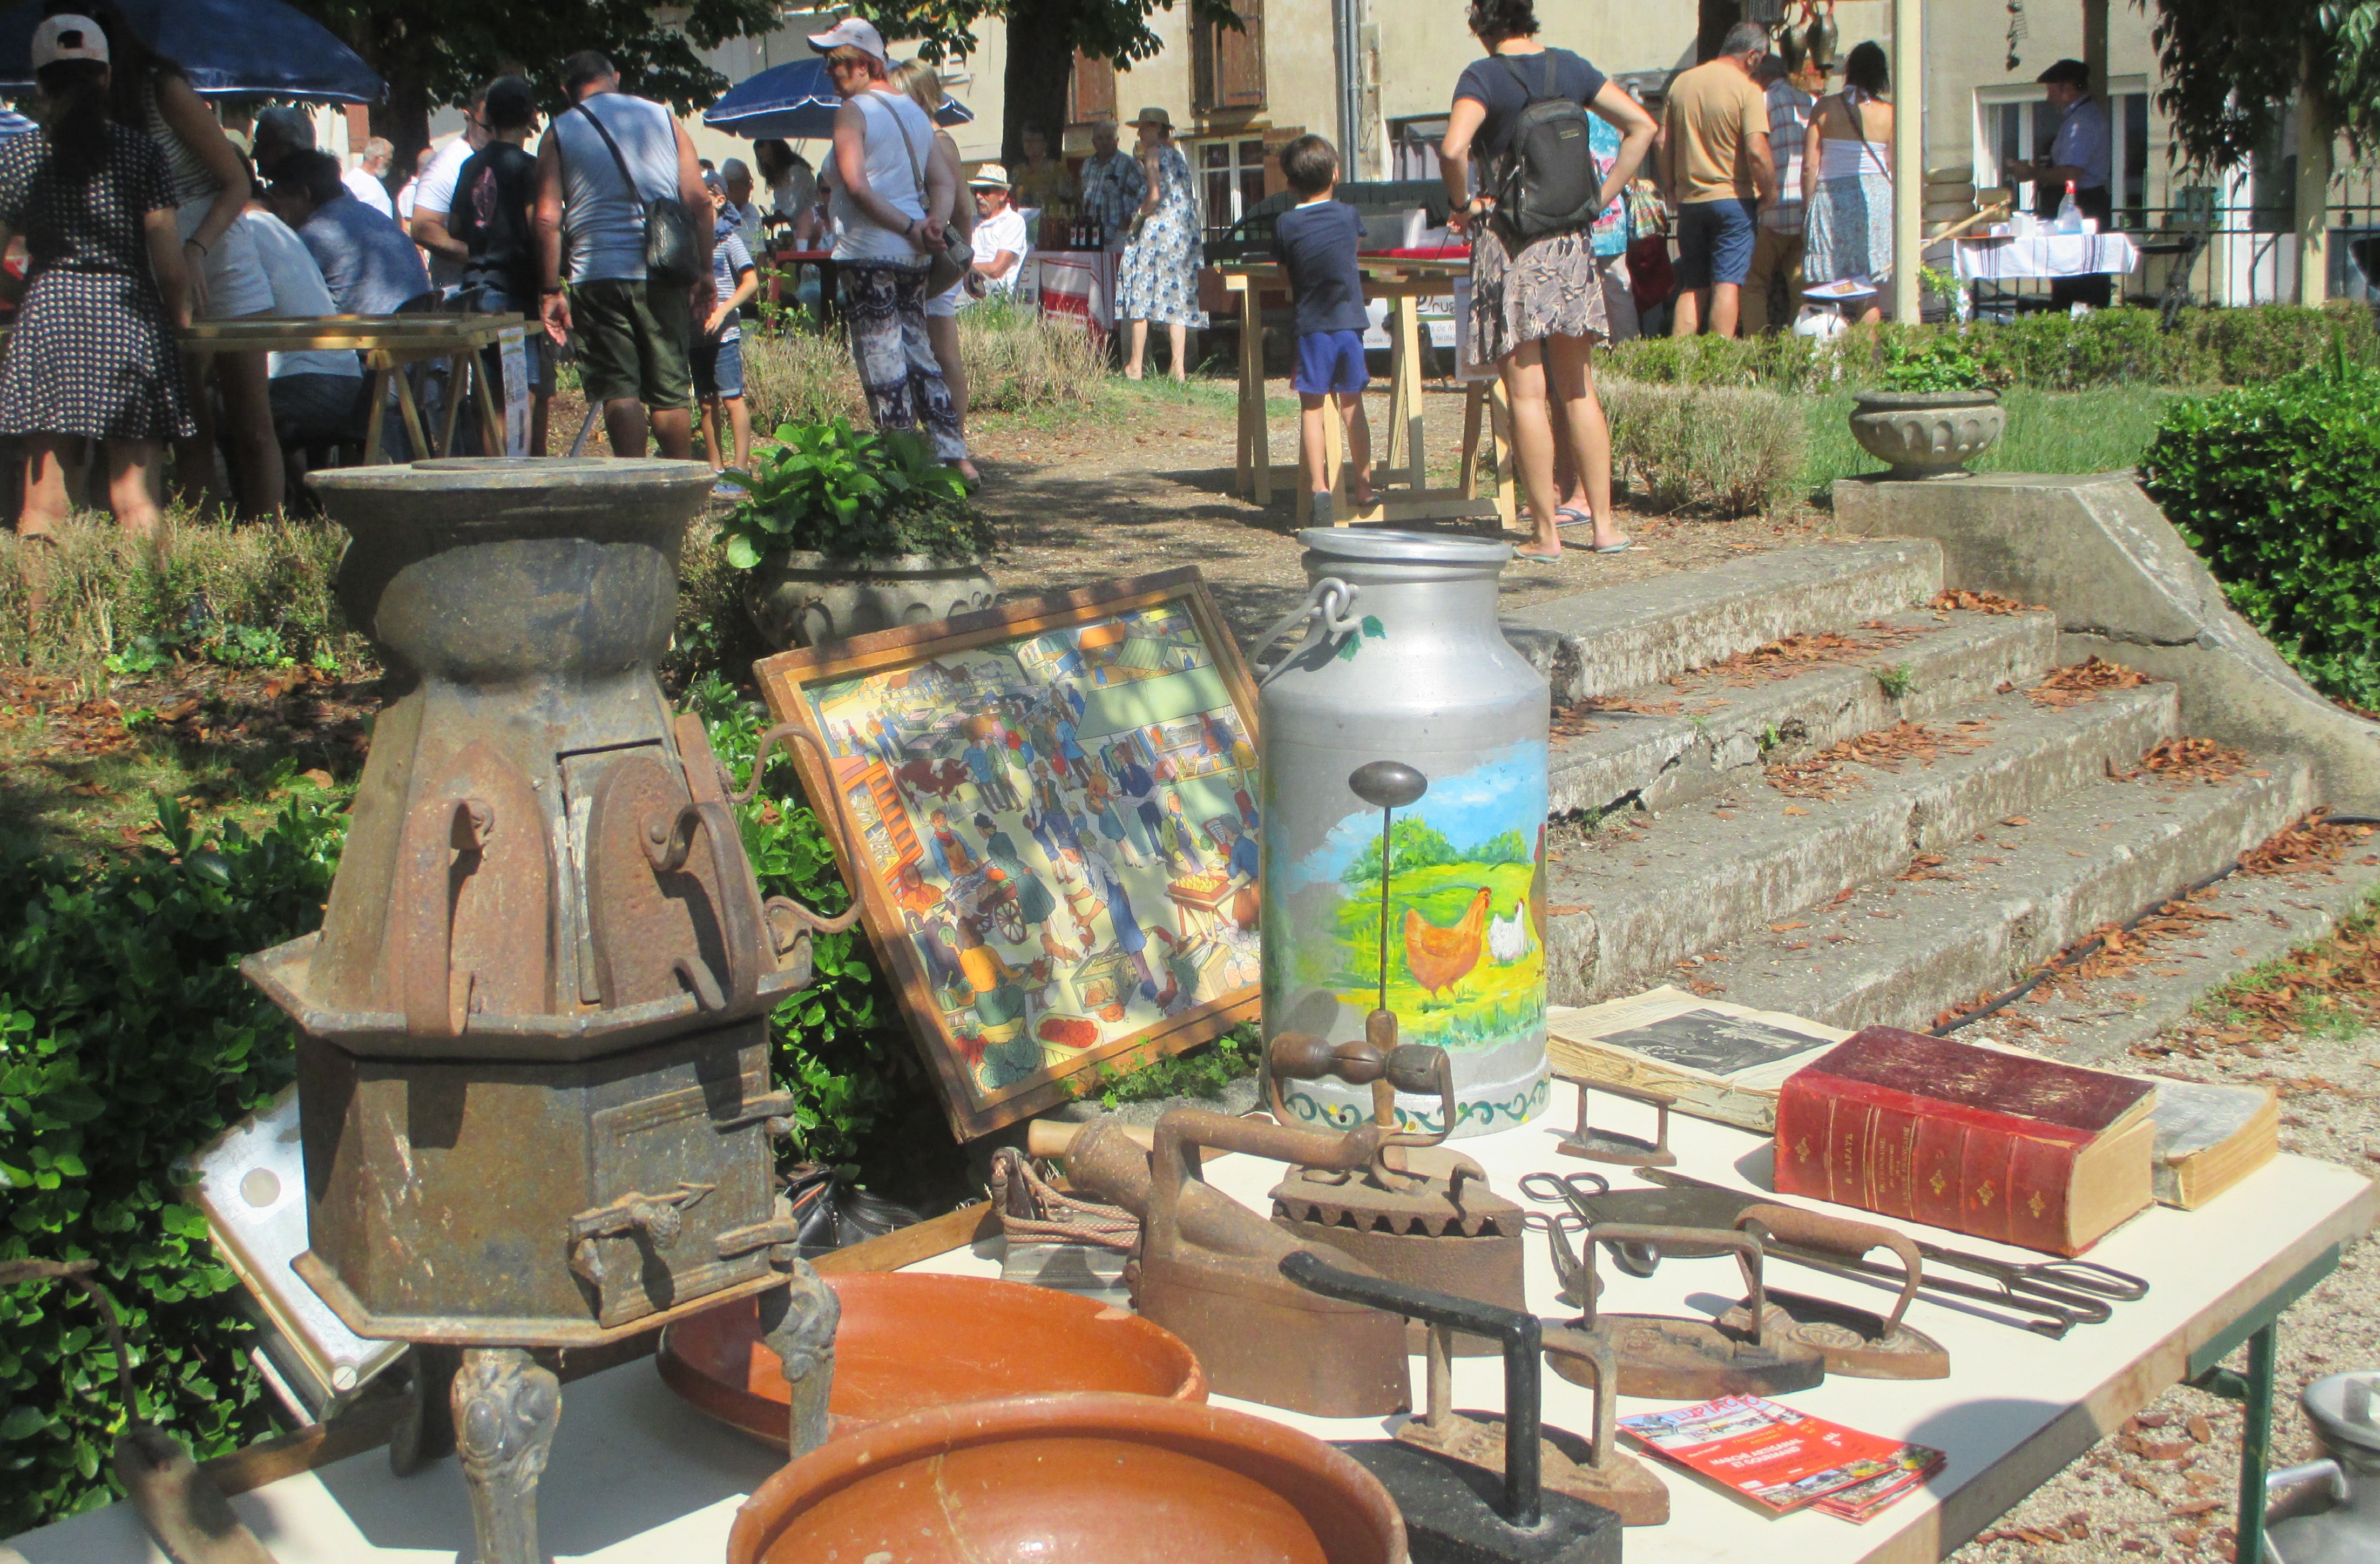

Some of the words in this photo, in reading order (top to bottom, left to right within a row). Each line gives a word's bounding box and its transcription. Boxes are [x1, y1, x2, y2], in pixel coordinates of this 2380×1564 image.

[1844, 1133, 1854, 1173] LAFAYE
[1708, 1452, 1753, 1466] MARCHÉ
[1750, 1438, 1805, 1457] ARTISANAL
[1743, 1445, 1801, 1465] GOURMAND
